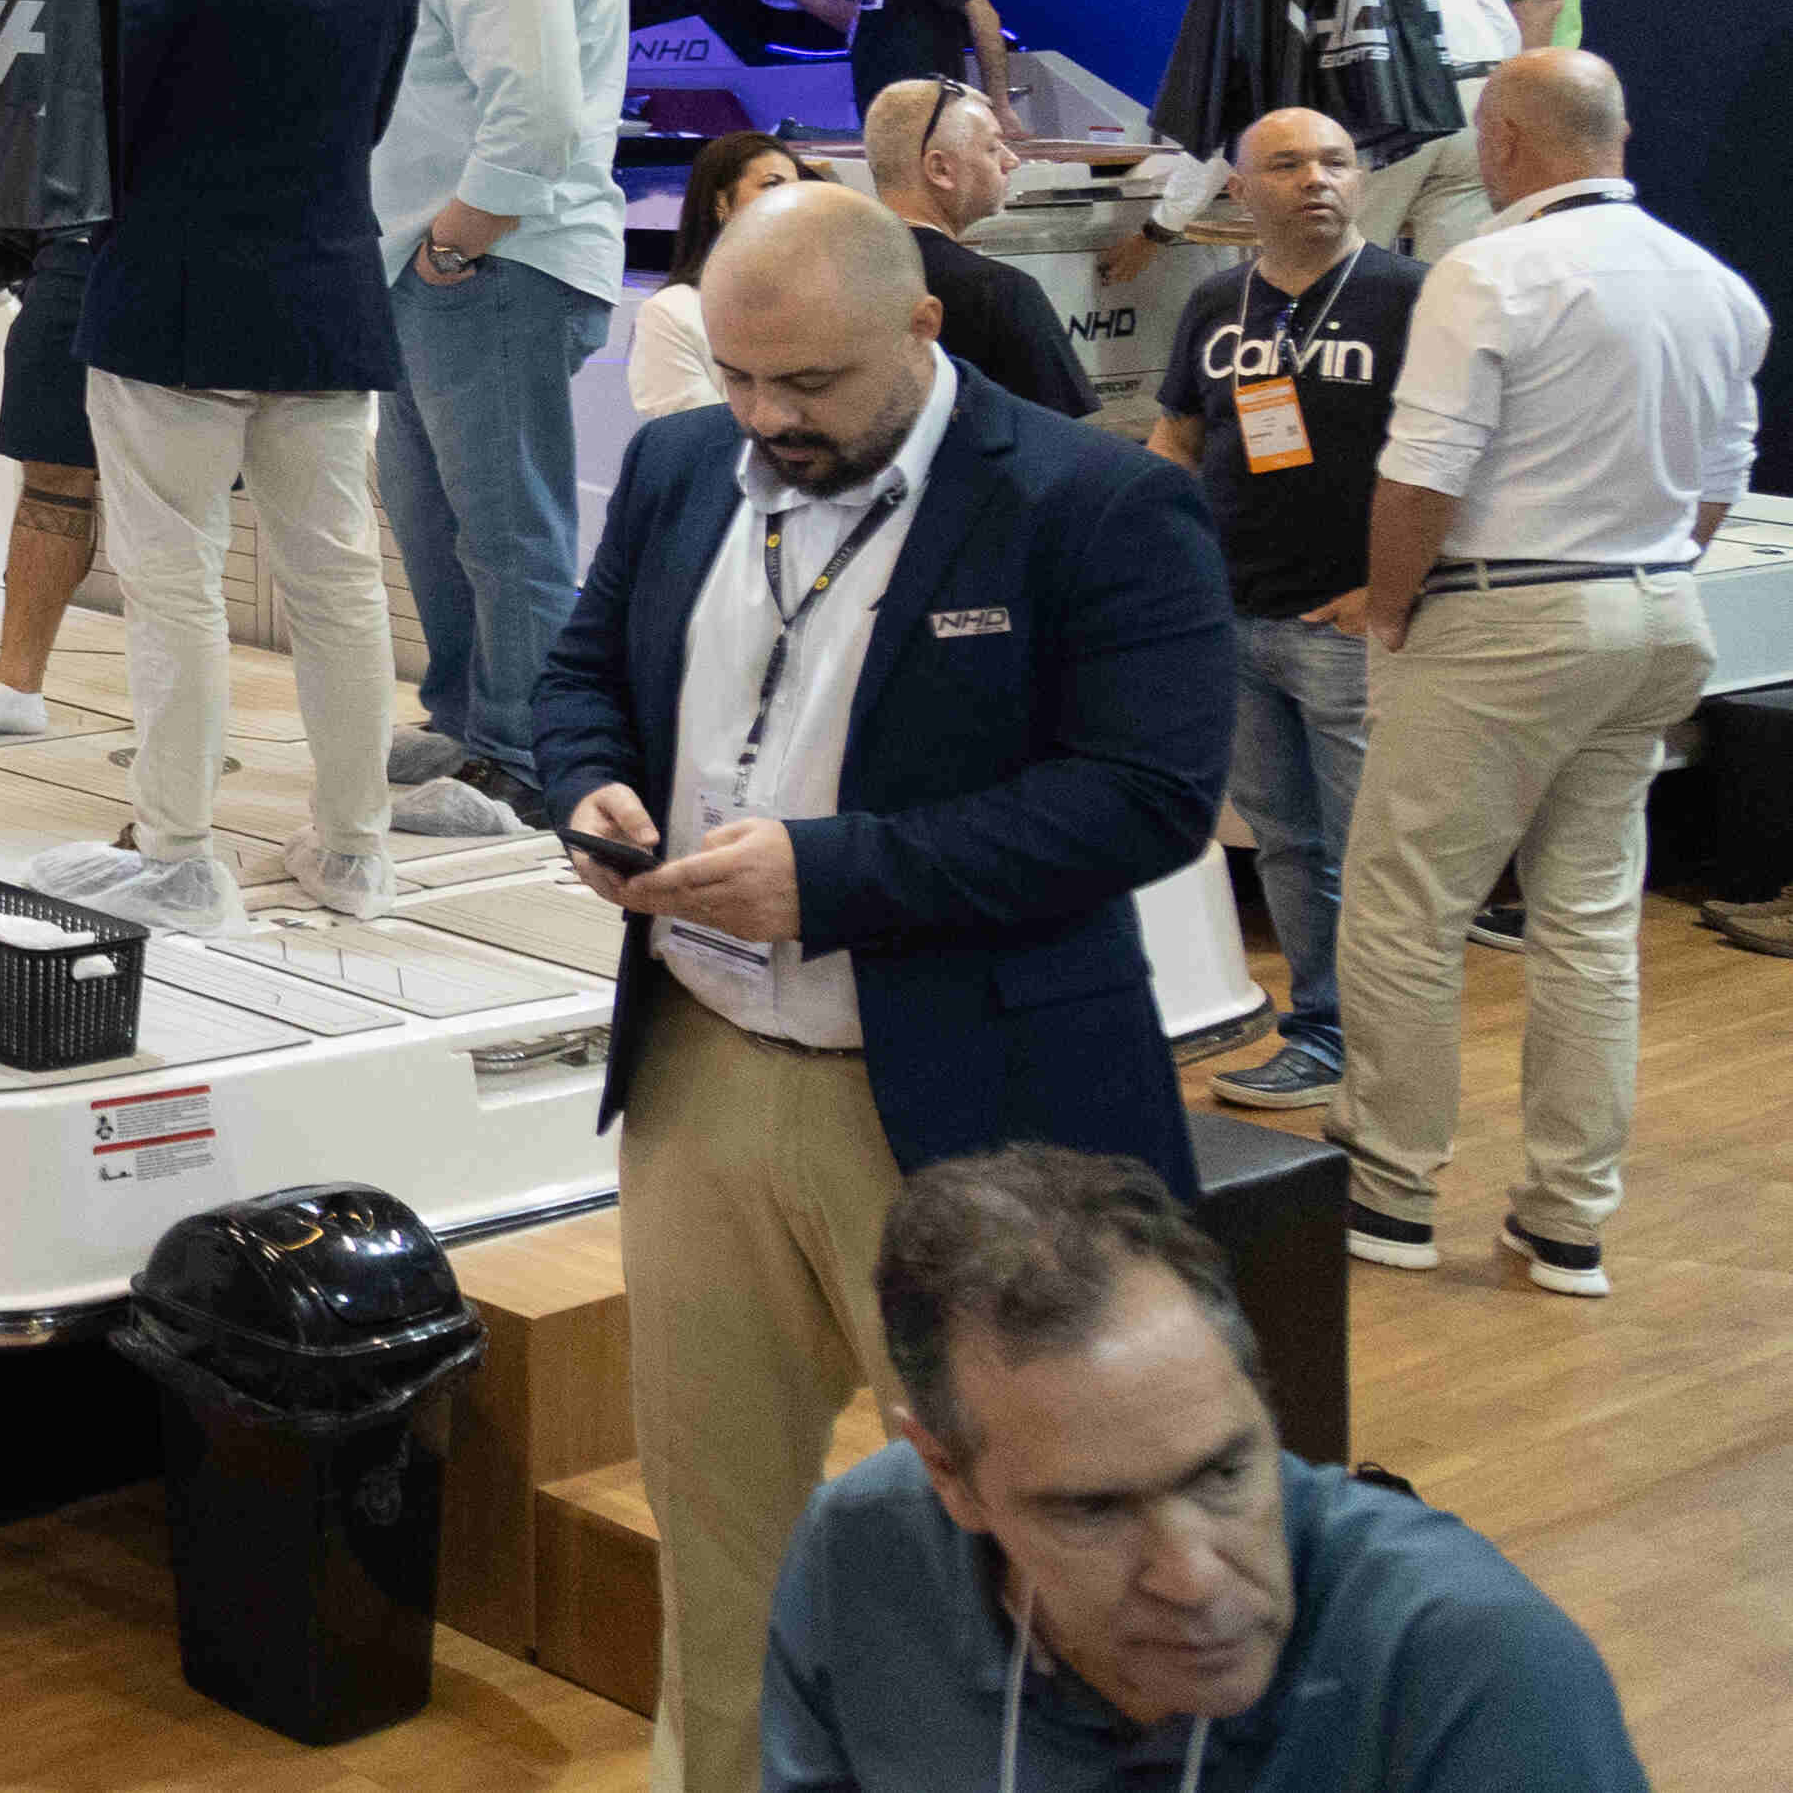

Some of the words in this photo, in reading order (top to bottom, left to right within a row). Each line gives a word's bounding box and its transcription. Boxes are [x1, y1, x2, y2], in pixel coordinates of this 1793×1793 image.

[629, 38, 710, 63] NHD
[1068, 308, 1137, 342] NHD
[1203, 321, 1374, 380] Calvin
[936, 608, 1007, 631] NHD
